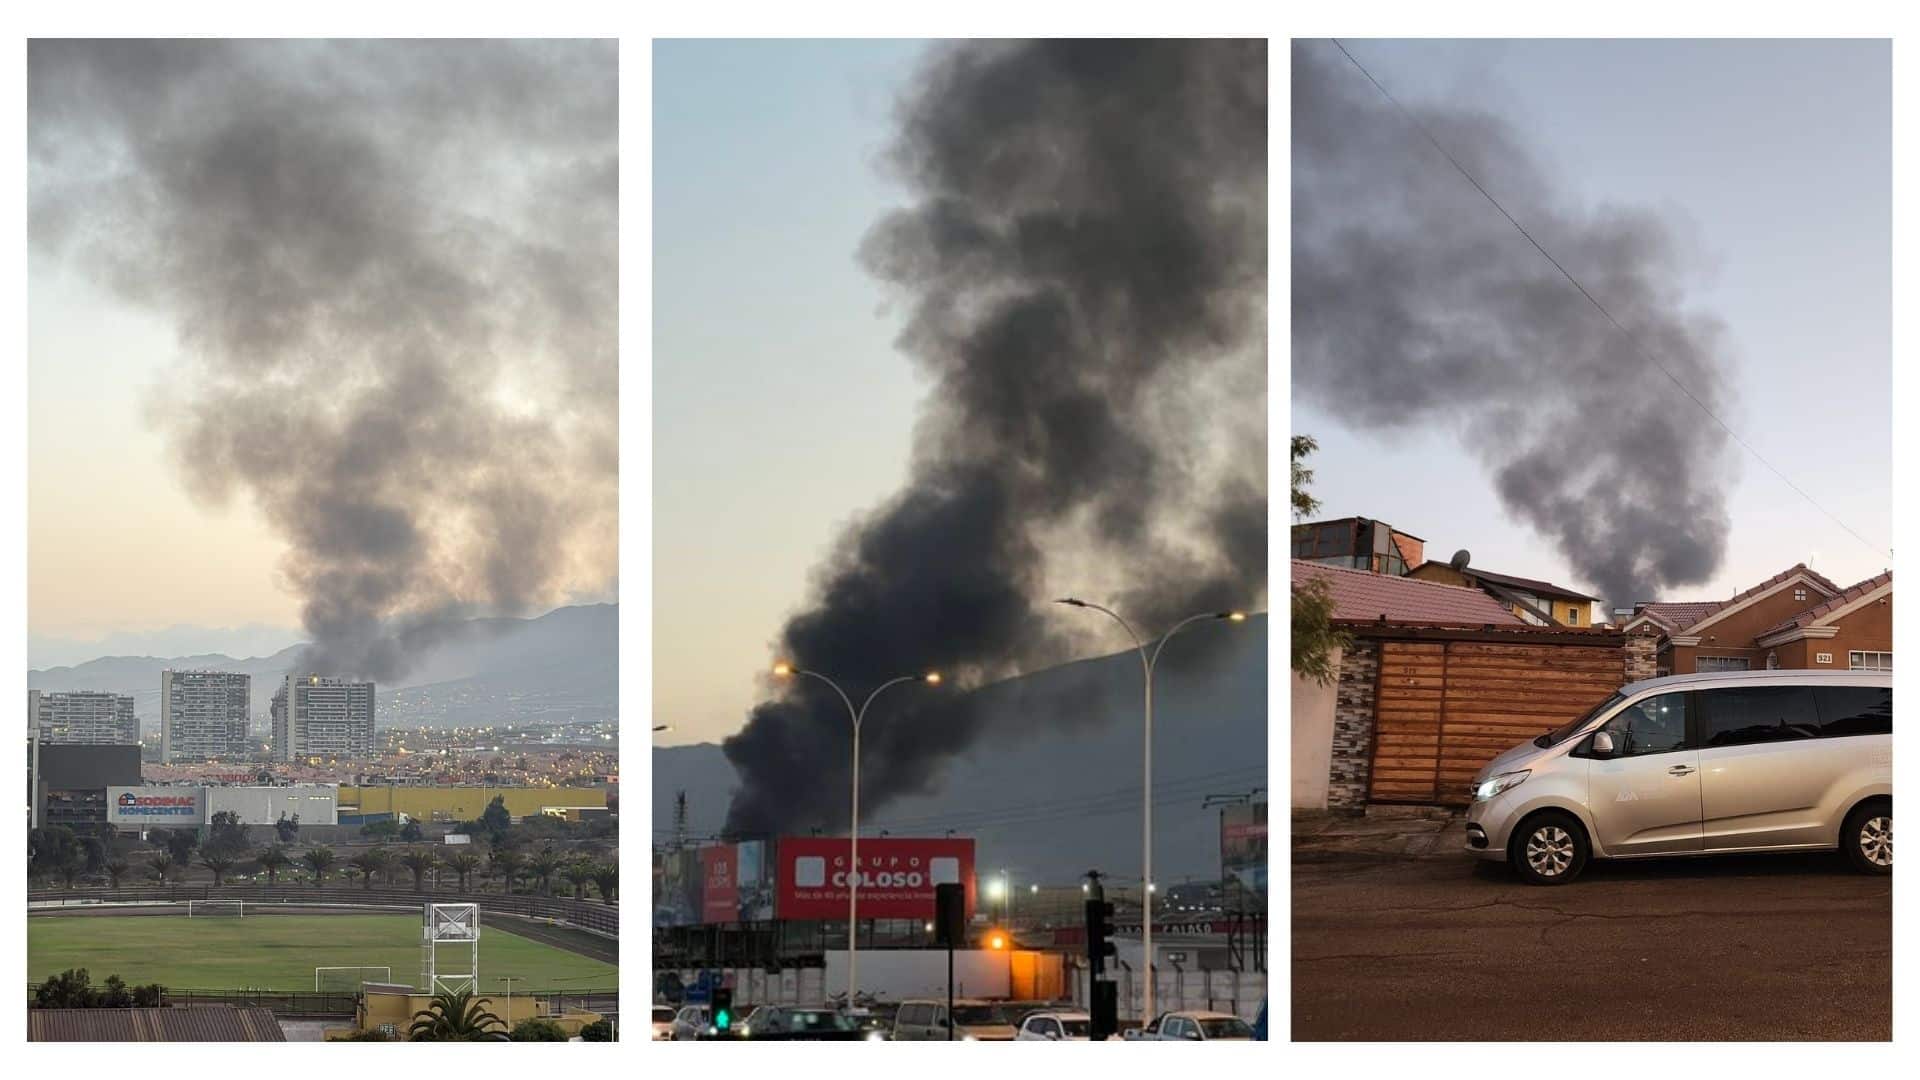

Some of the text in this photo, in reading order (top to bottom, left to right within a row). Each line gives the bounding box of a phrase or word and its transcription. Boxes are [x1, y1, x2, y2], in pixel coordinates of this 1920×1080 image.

[136, 796, 194, 806] SODIMAC
[118, 806, 194, 815] HOMECENTER
[832, 871, 922, 887] COLOSO
